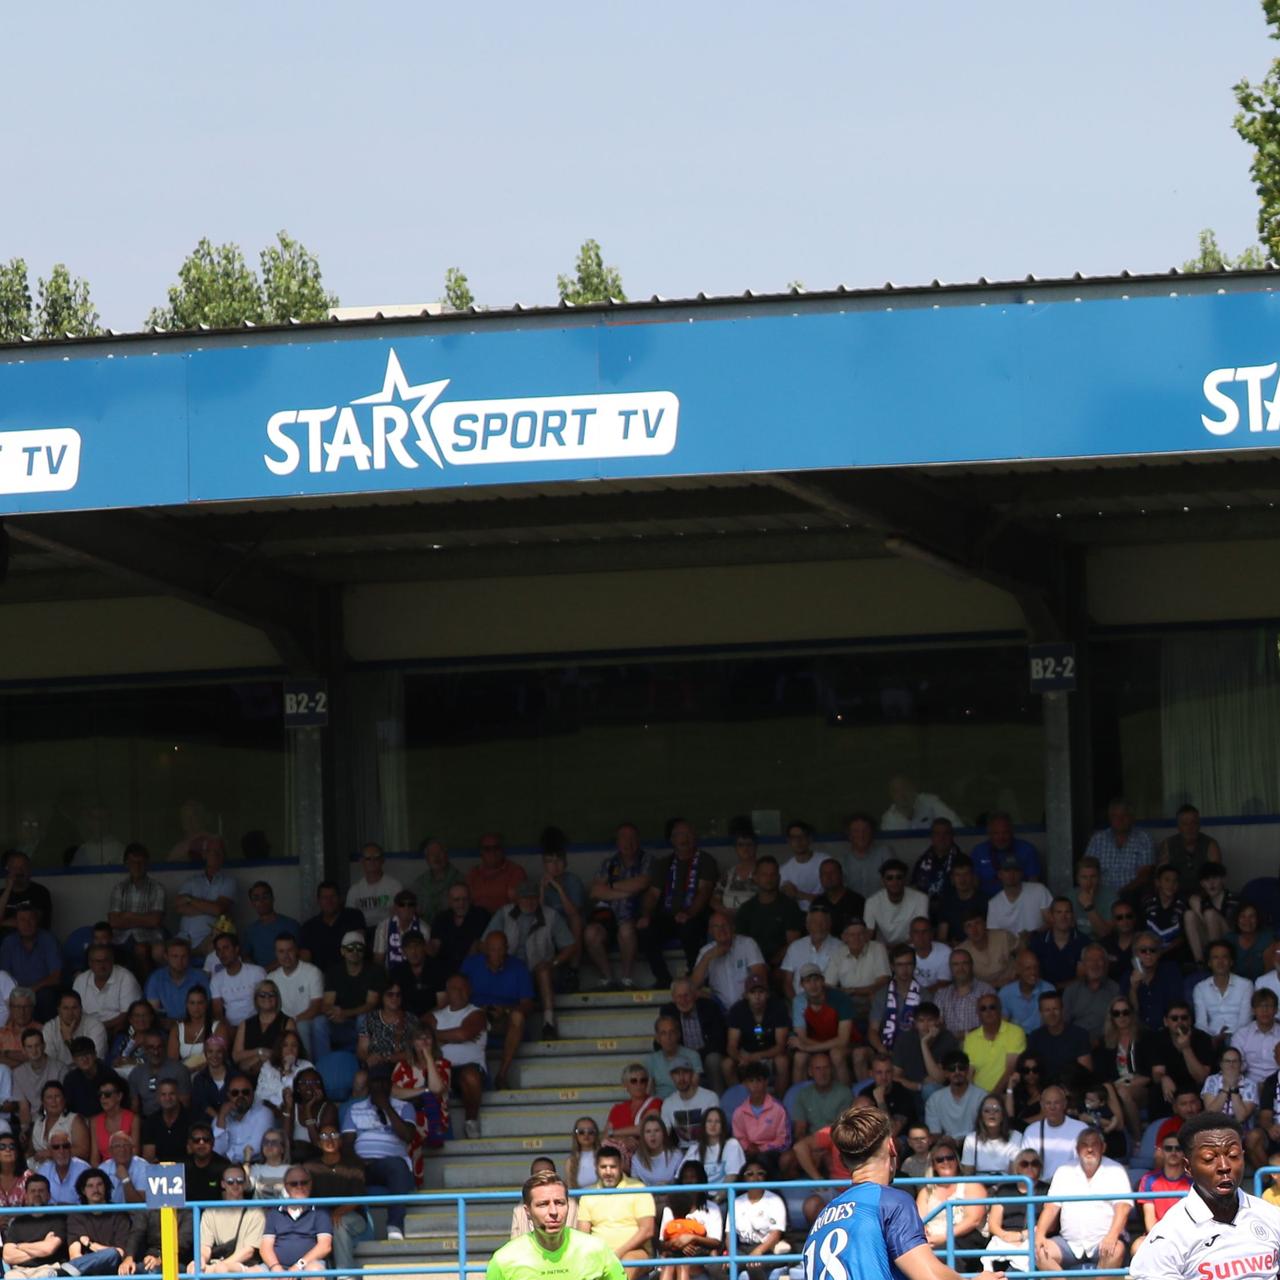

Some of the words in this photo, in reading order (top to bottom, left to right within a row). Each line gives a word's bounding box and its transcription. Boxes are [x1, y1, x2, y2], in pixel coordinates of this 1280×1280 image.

[263, 403, 421, 477] STAR
[451, 408, 597, 452] SPORT
[619, 407, 666, 440] TV
[22, 444, 67, 477] TV
[1030, 654, 1075, 681] B2-2
[285, 690, 328, 716] B2-2
[148, 1175, 184, 1196] V1.2
